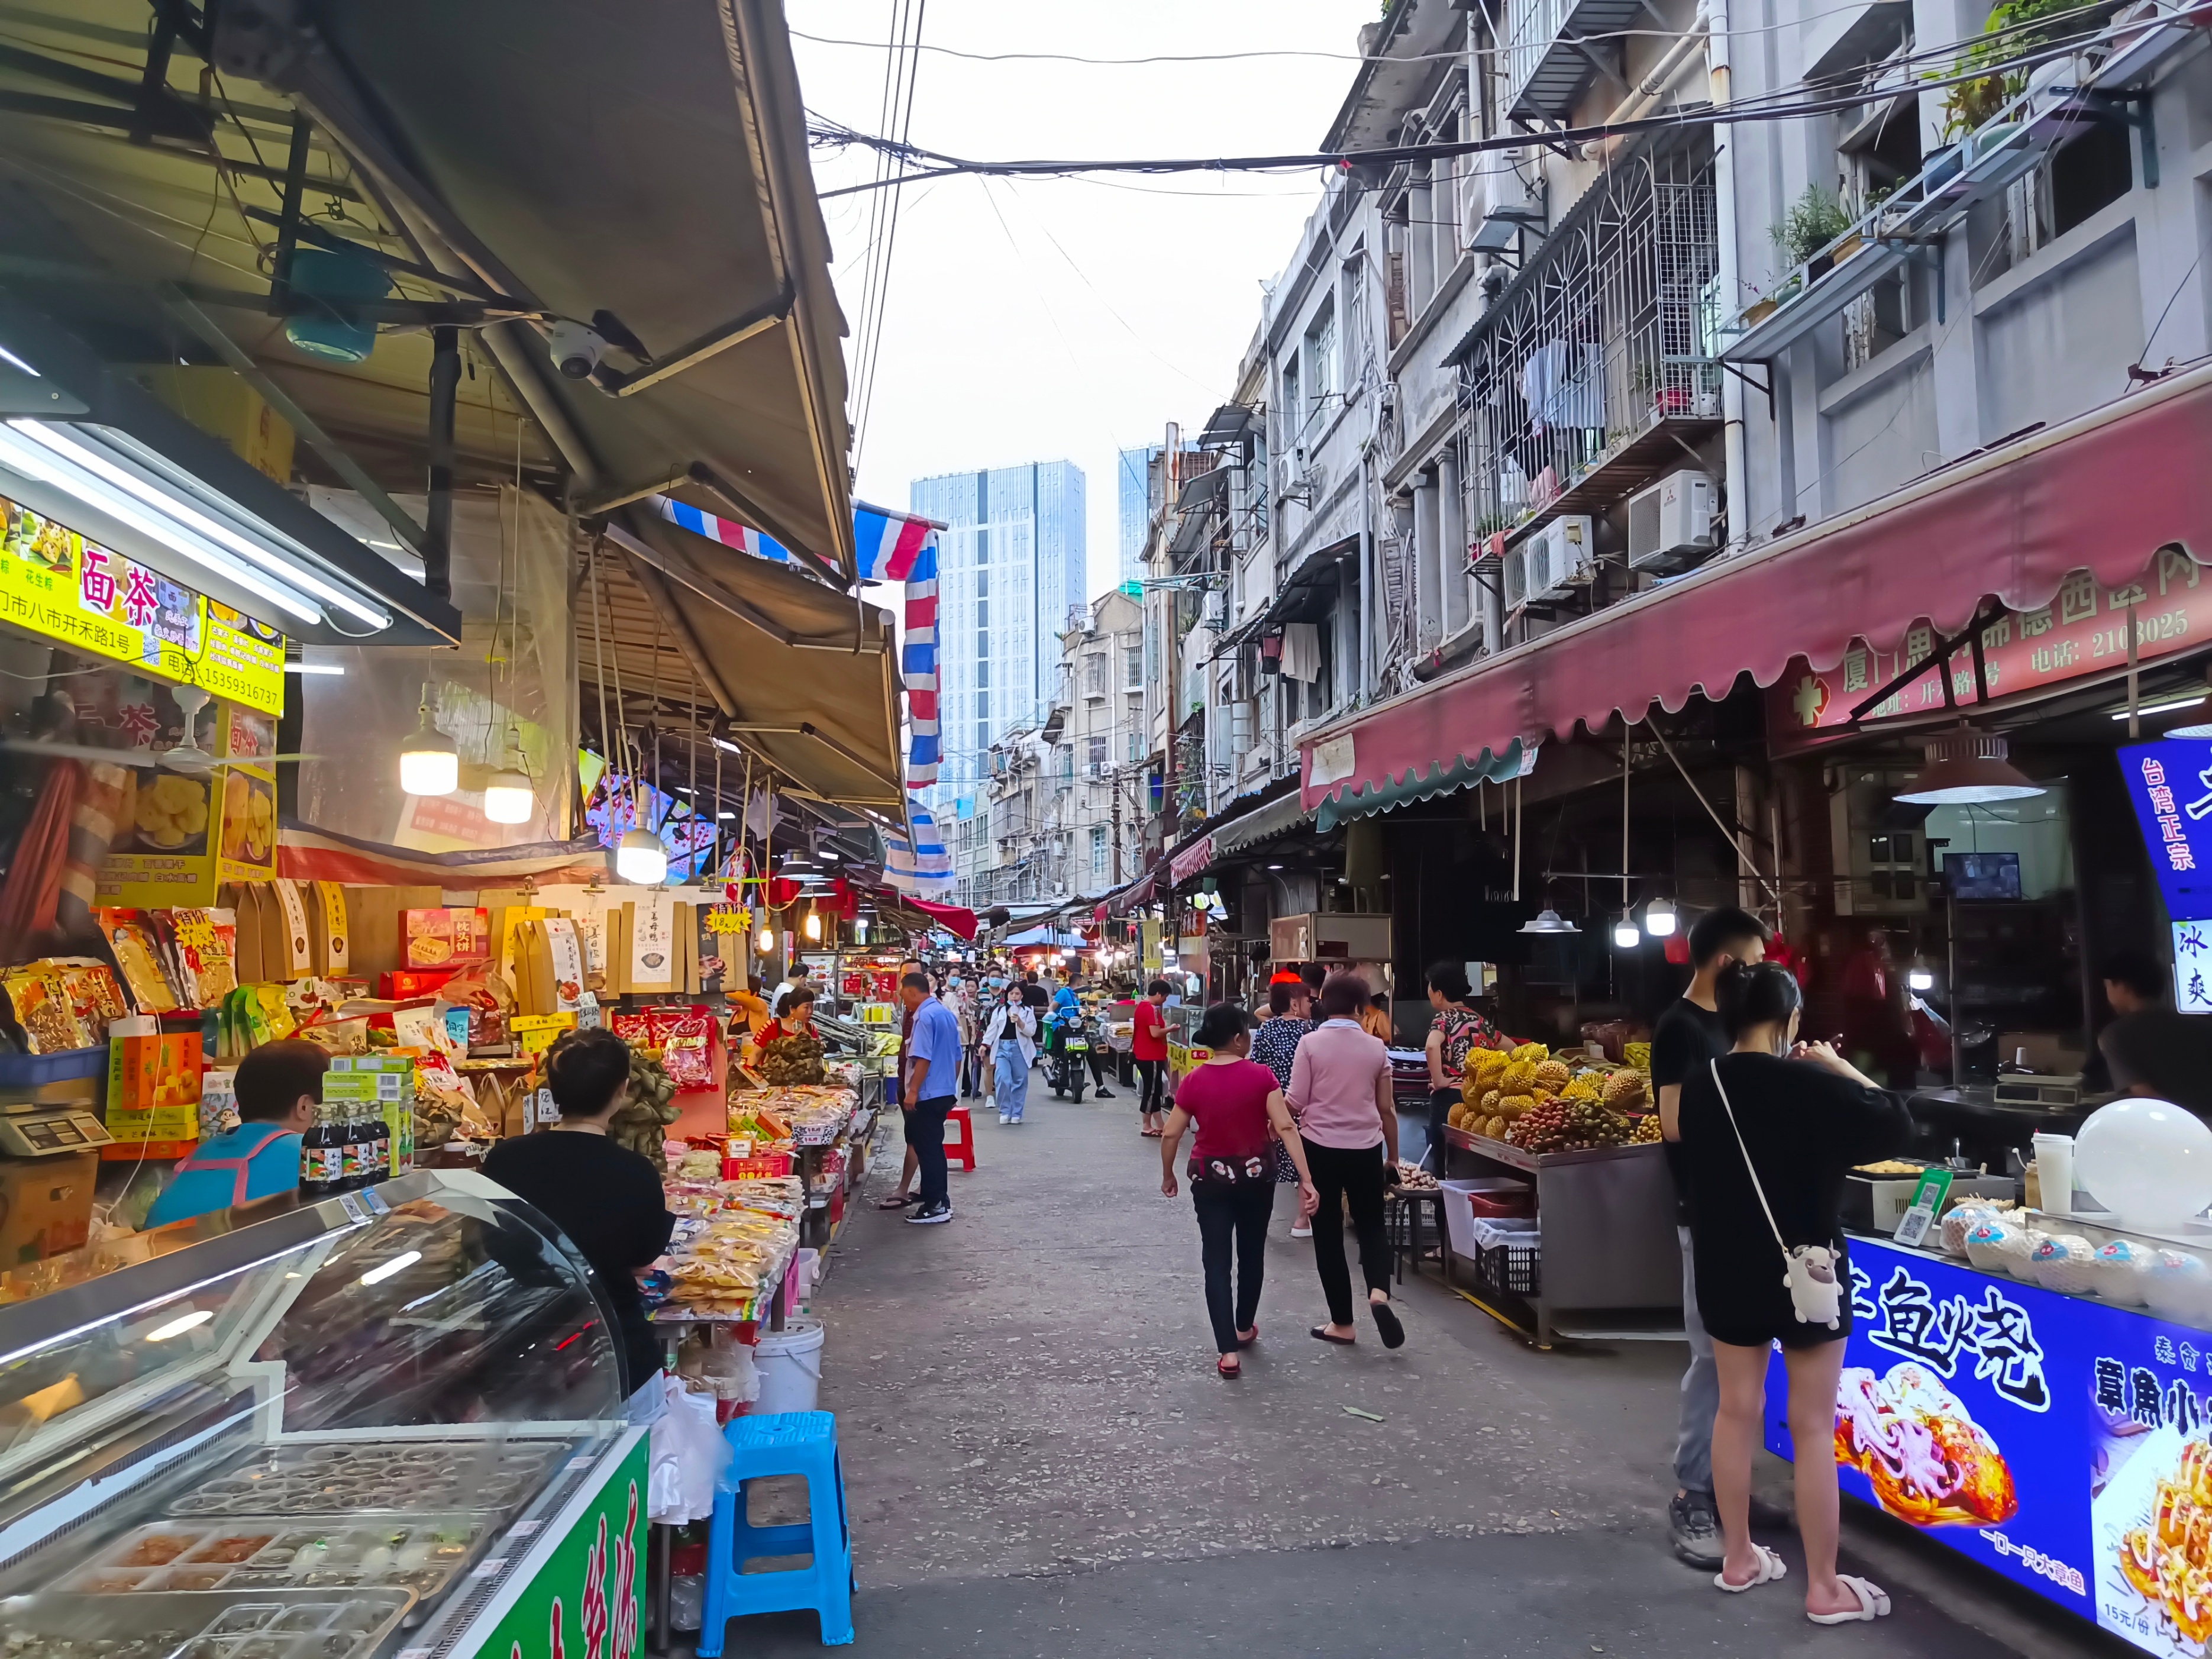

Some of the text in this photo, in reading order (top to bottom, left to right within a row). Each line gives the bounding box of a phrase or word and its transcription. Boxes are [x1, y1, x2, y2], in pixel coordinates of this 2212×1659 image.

[26, 569, 53, 591] 花生粽
[83, 550, 159, 627] 面茶
[2142, 757, 2195, 870] 台湾正宗
[177, 909, 206, 927] 特价
[716, 903, 744, 915] 特价
[456, 921, 470, 952] 枕头饼
[2179, 925, 2212, 1006] 冰爽
[2095, 1357, 2212, 1447] 章魚小
[1980, 1529, 2086, 1596] 一口一只大章鱼
[2105, 1604, 2149, 1636] 15元/份
